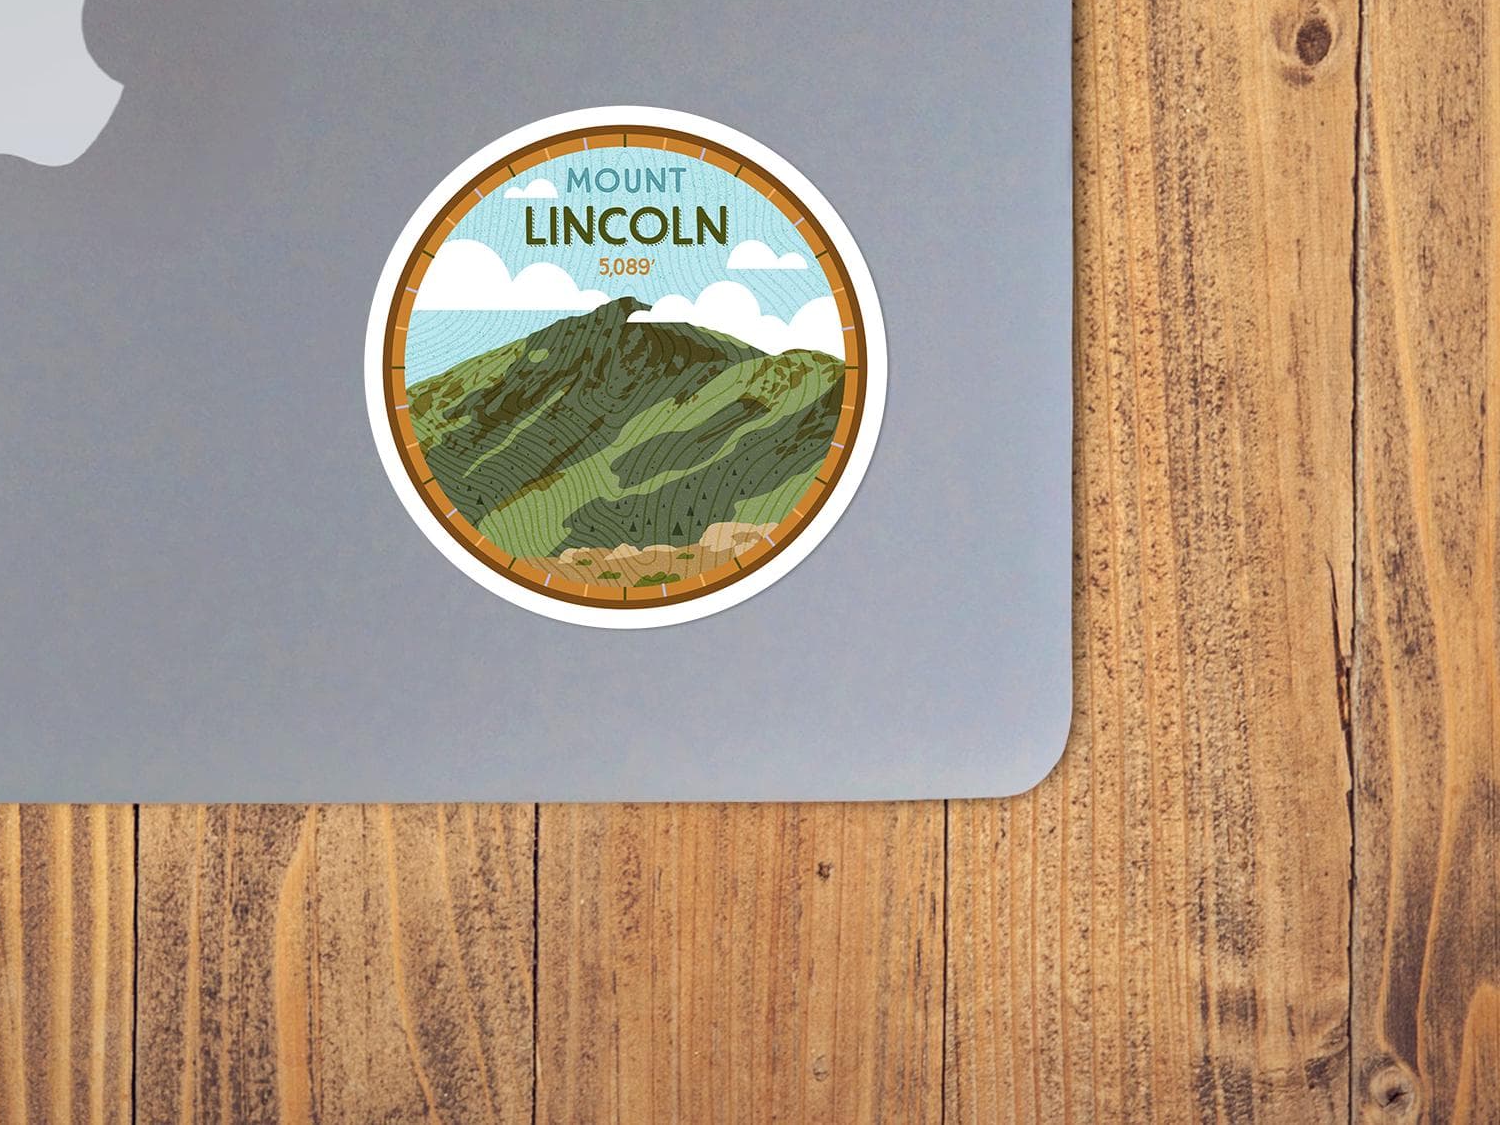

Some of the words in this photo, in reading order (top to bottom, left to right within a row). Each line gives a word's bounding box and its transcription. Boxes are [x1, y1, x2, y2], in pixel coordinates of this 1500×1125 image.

[566, 167, 687, 194] MOUNT
[525, 206, 729, 248] LINCOLN
[599, 257, 656, 279] 5,089'
